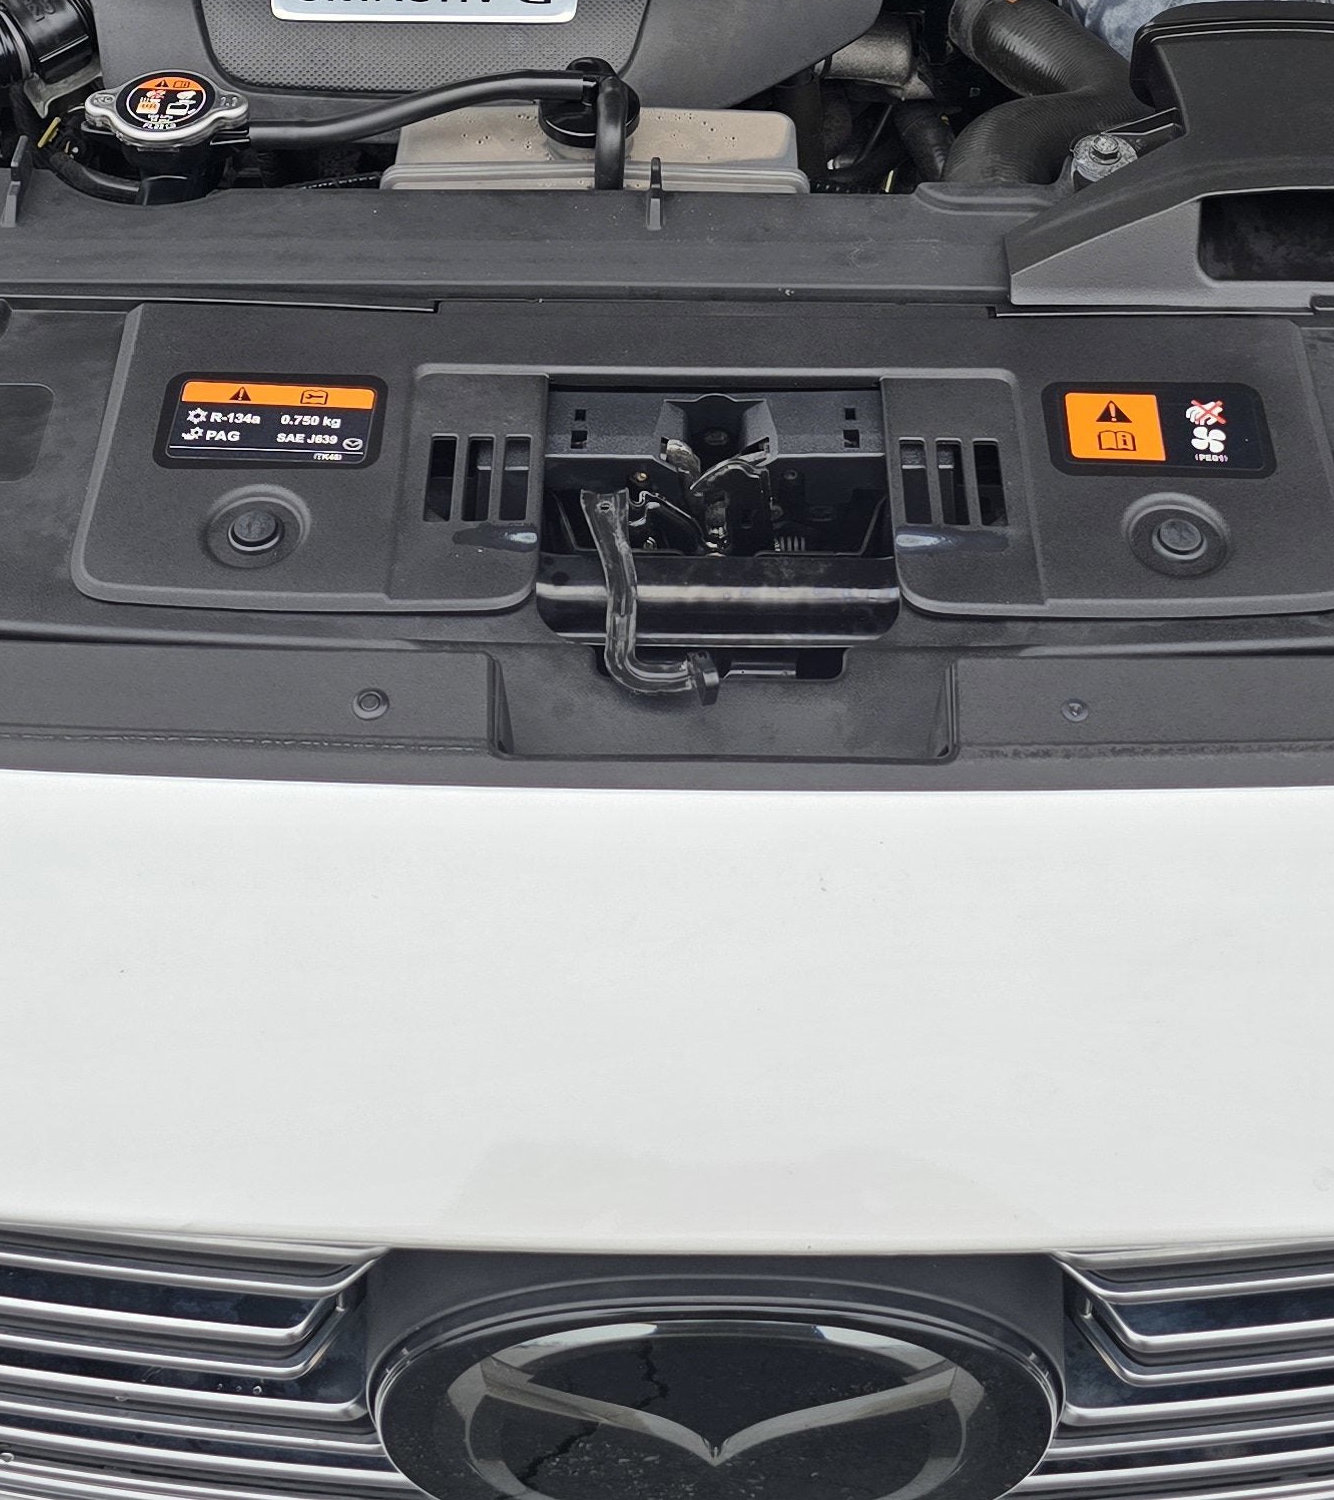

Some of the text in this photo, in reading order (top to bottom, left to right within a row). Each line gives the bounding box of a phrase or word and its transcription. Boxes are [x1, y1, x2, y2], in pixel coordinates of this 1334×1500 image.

[209, 412, 342, 429] R-134a 0.750 kg
[205, 430, 338, 445] PAG SAE J639
